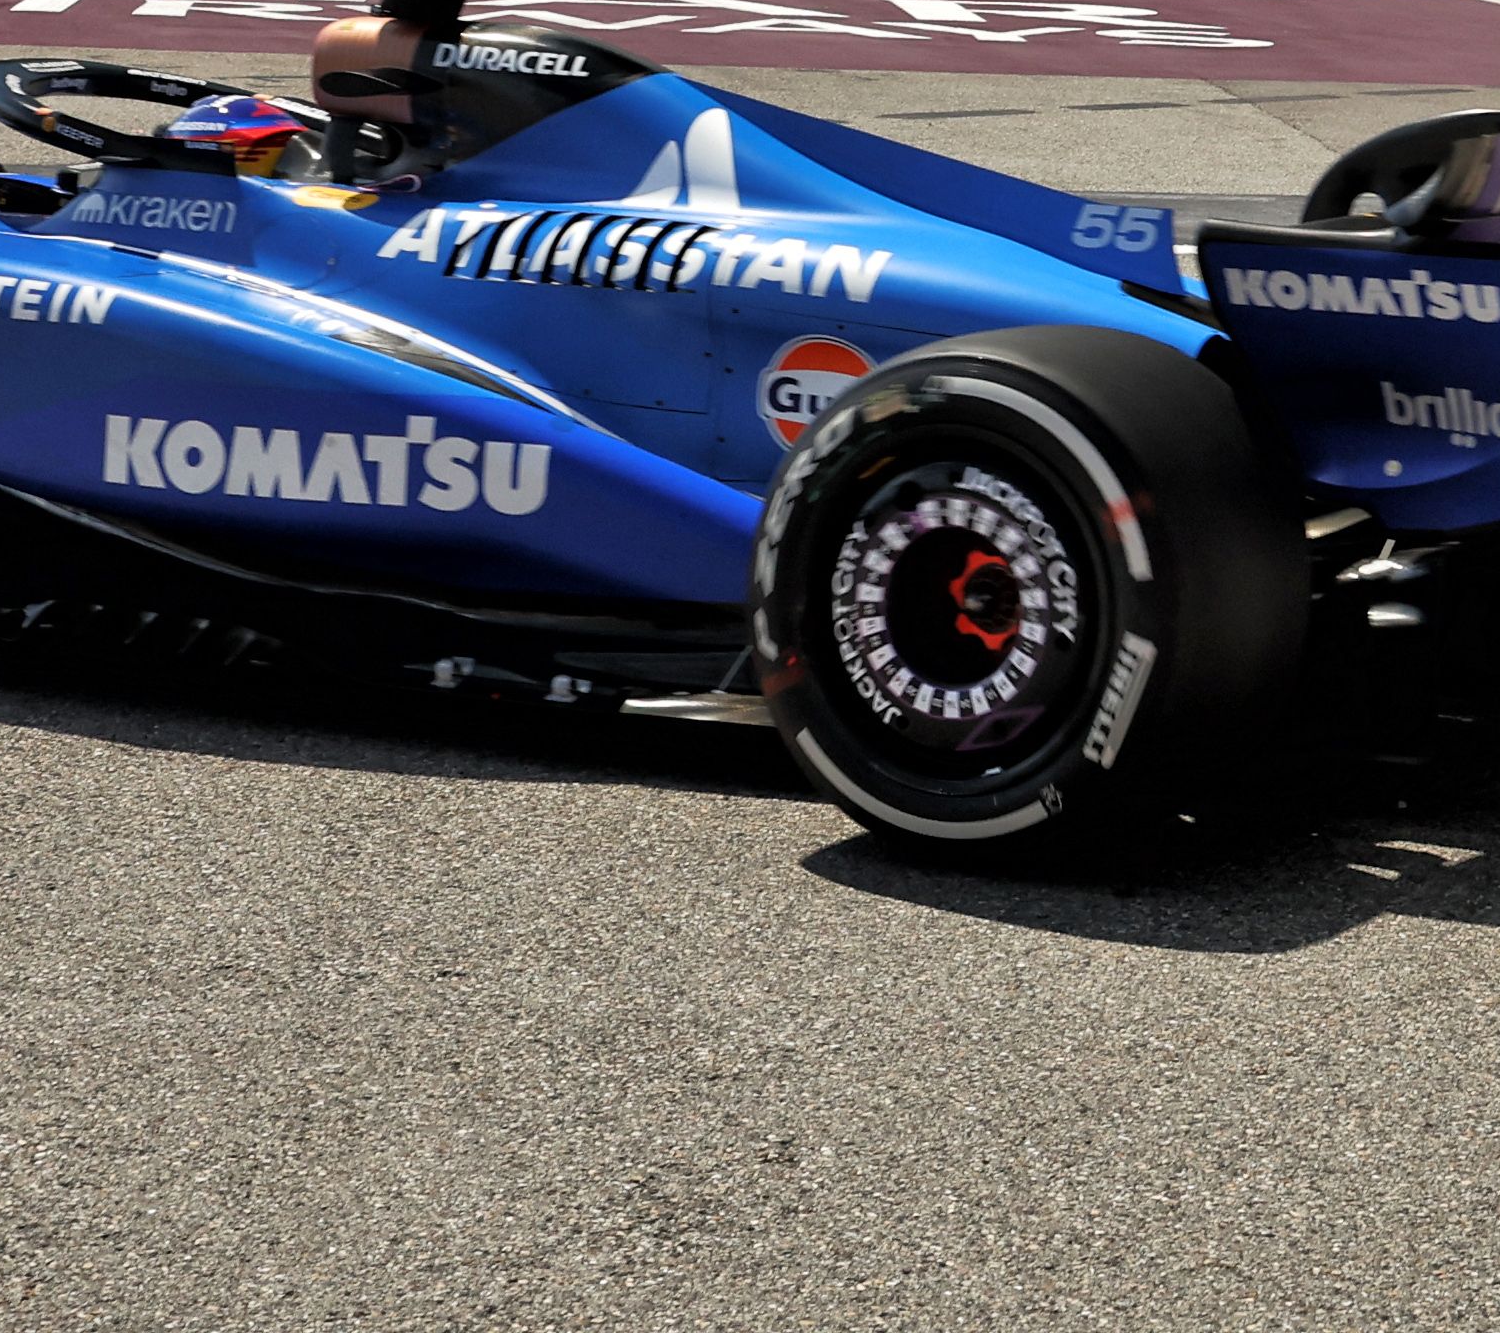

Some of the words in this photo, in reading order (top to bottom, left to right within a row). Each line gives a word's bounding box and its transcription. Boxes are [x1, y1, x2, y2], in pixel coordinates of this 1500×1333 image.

[433, 42, 590, 78] DURACELL
[105, 194, 236, 234] kraken
[1071, 204, 1165, 253] 55
[377, 206, 893, 304] ATLASSIAN
[103, 414, 553, 516] KOMATSU
